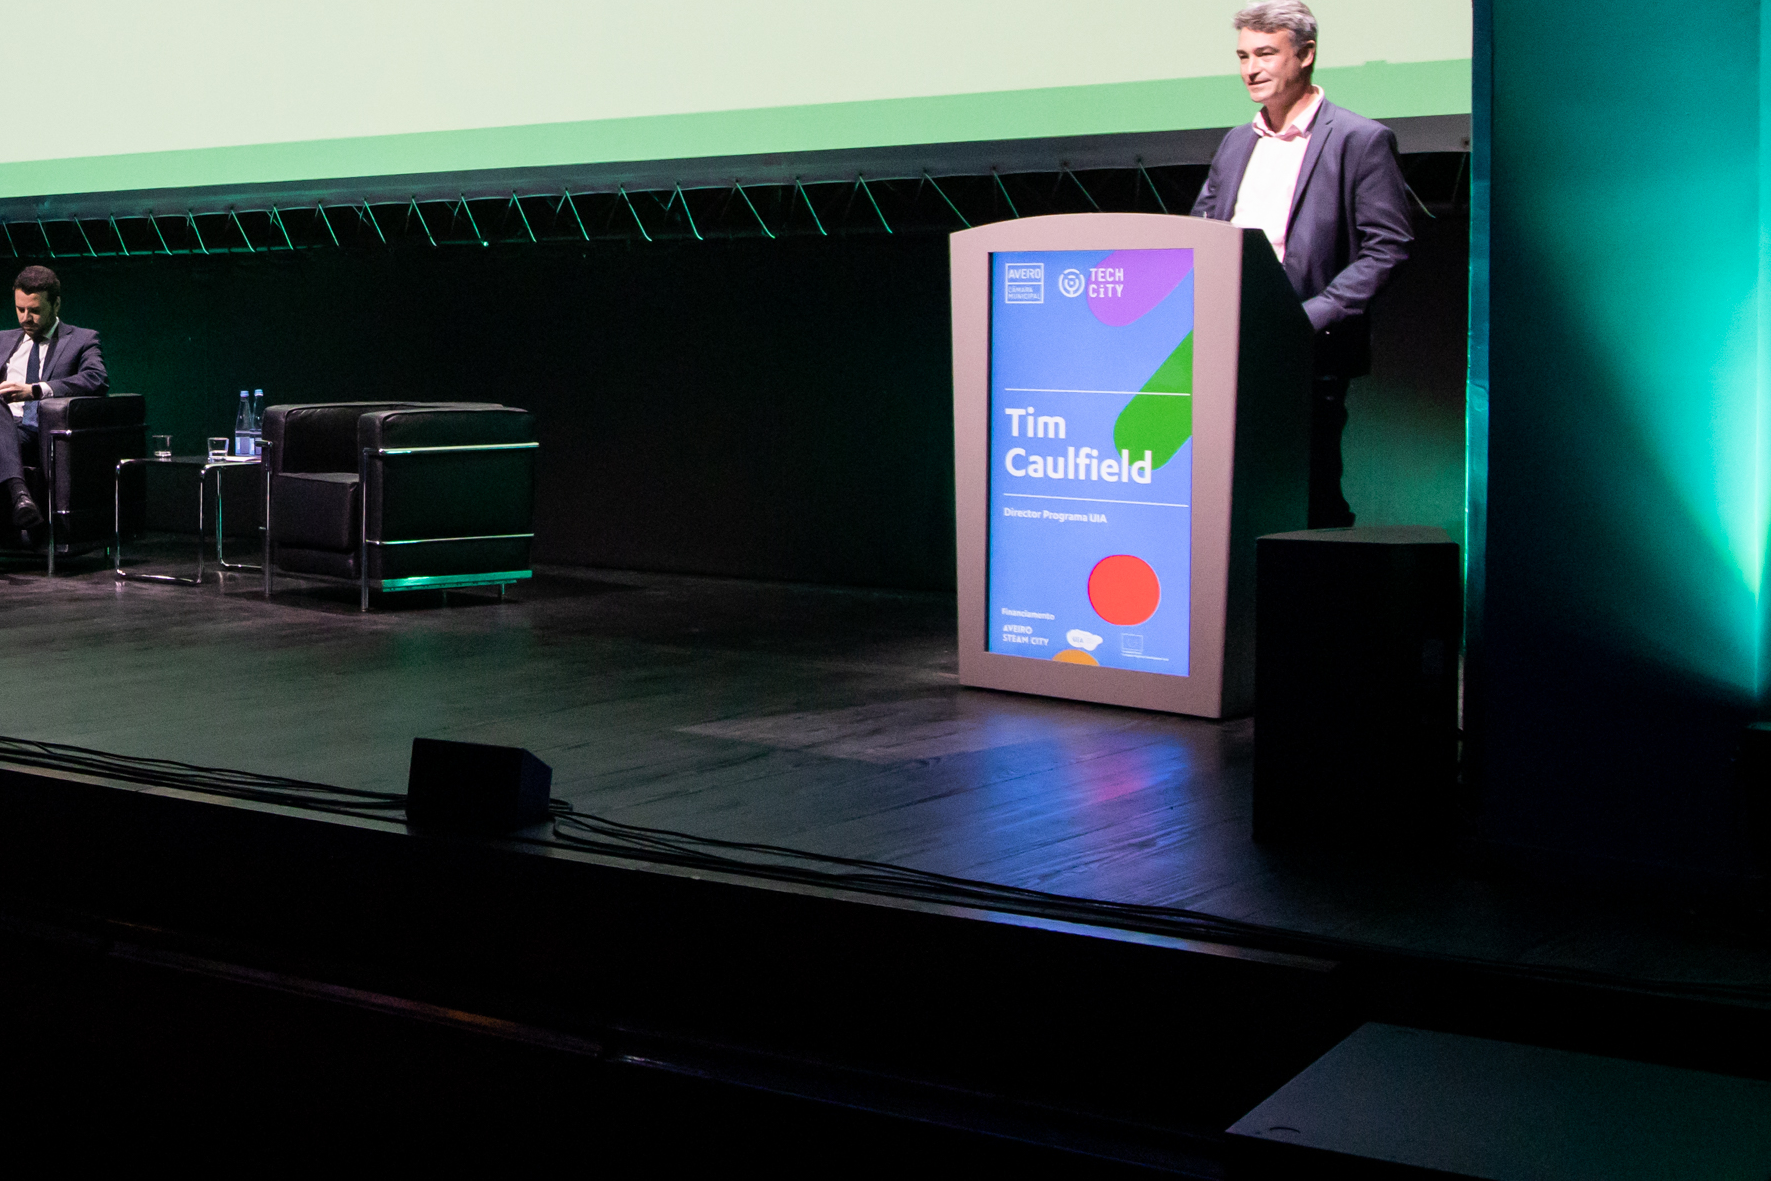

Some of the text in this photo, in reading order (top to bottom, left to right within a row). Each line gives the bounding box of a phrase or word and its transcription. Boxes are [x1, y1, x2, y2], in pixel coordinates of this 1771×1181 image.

[1089, 267, 1124, 281] TECH
[1004, 406, 1066, 439] Tim
[1004, 446, 1153, 484] Caulfield
[1003, 506, 1108, 524] Director Programa UIA
[1002, 624, 1034, 635] AVEIRO
[1002, 634, 1050, 647] STEAM CITY
